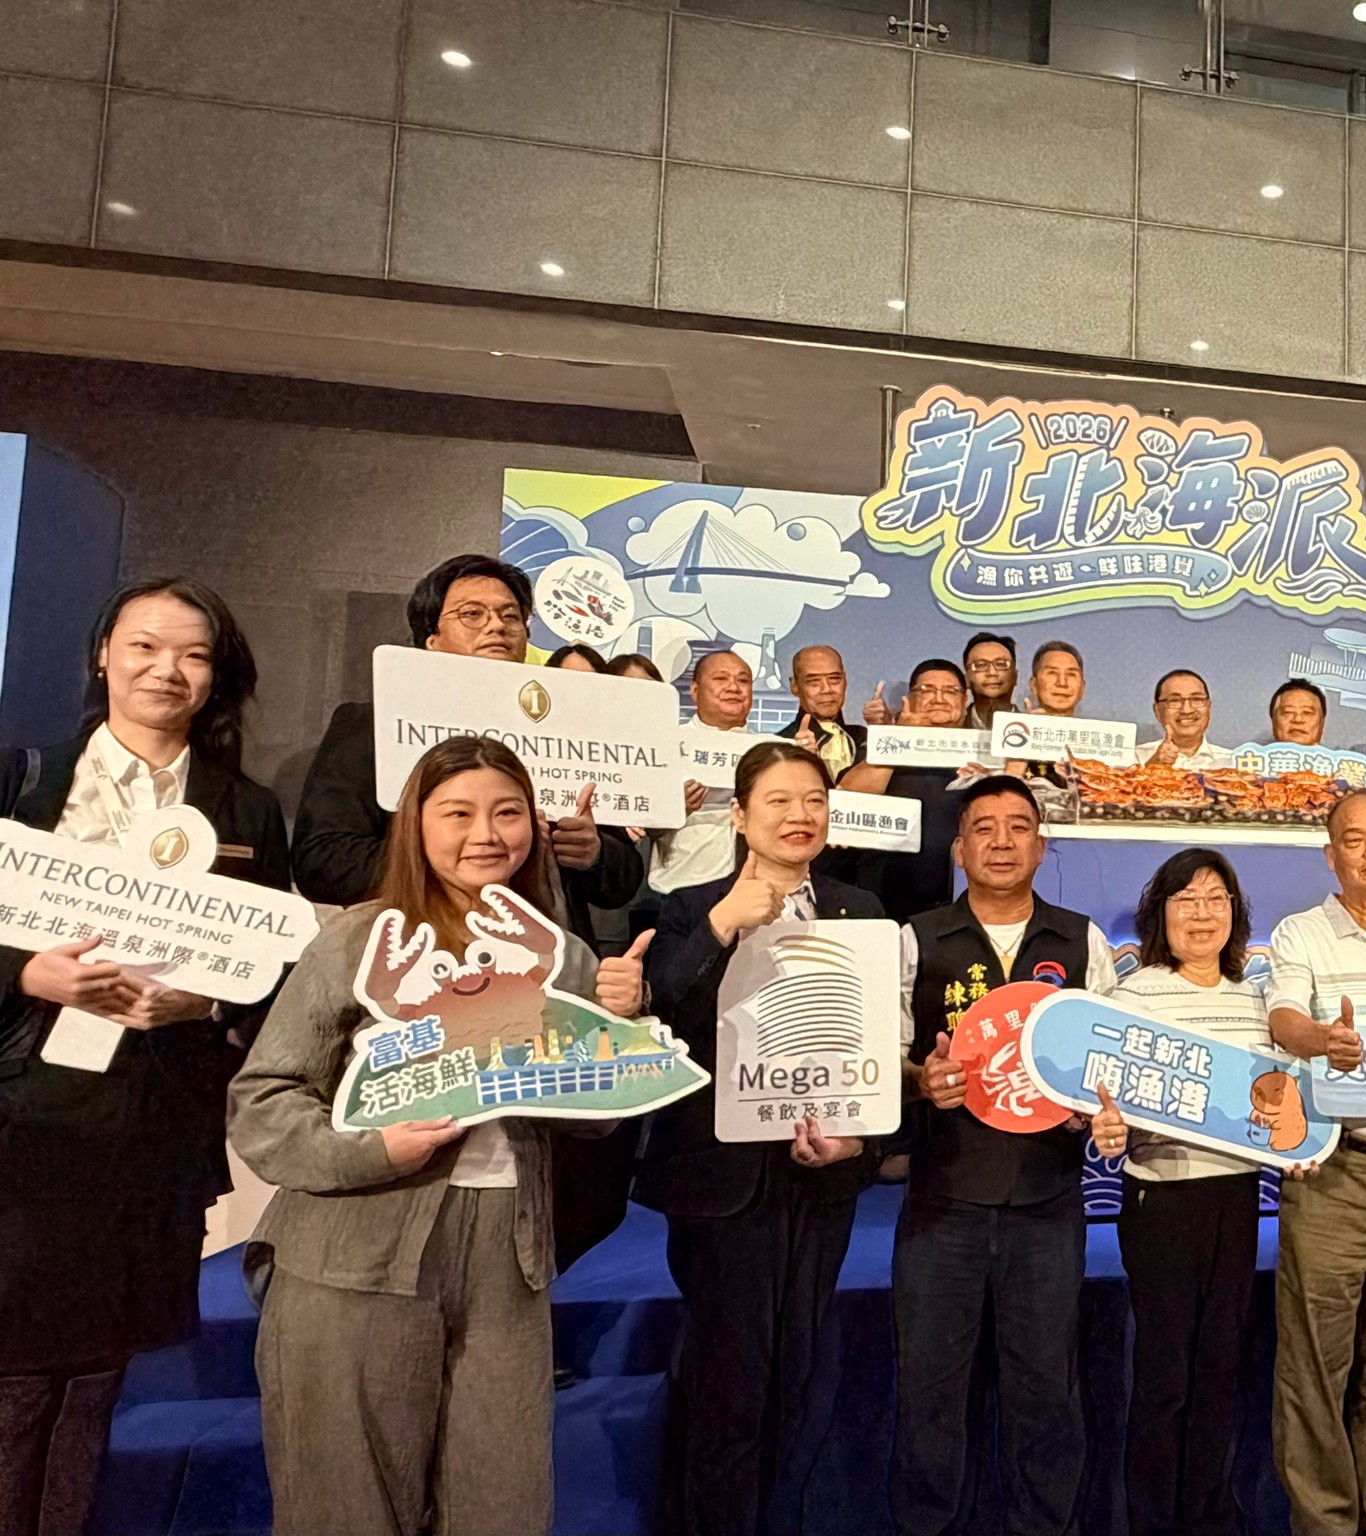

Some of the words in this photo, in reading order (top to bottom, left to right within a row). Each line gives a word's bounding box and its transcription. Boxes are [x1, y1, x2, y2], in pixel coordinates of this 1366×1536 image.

[1047, 413, 1111, 444] 2026
[976, 562, 1074, 587] 漁你共遊
[540, 767, 570, 780] HOT
[574, 769, 622, 784] SPRING
[0, 842, 291, 938] NTERCONTINENTAL
[40, 890, 83, 909] NEW
[85, 900, 132, 922] TAIPEI
[136, 912, 173, 931] HOT
[175, 922, 234, 946] SPRING
[367, 1017, 442, 1070] 富基
[979, 1002, 1038, 1040] 萬里
[1092, 1023, 1212, 1079] 一起新北
[363, 1048, 475, 1115] 活海鮮
[738, 1061, 831, 1095] Mega
[841, 1058, 880, 1087] 50
[1082, 1050, 1209, 1125] 嗨漁港
[757, 1100, 862, 1123] 餐飲及宴會
